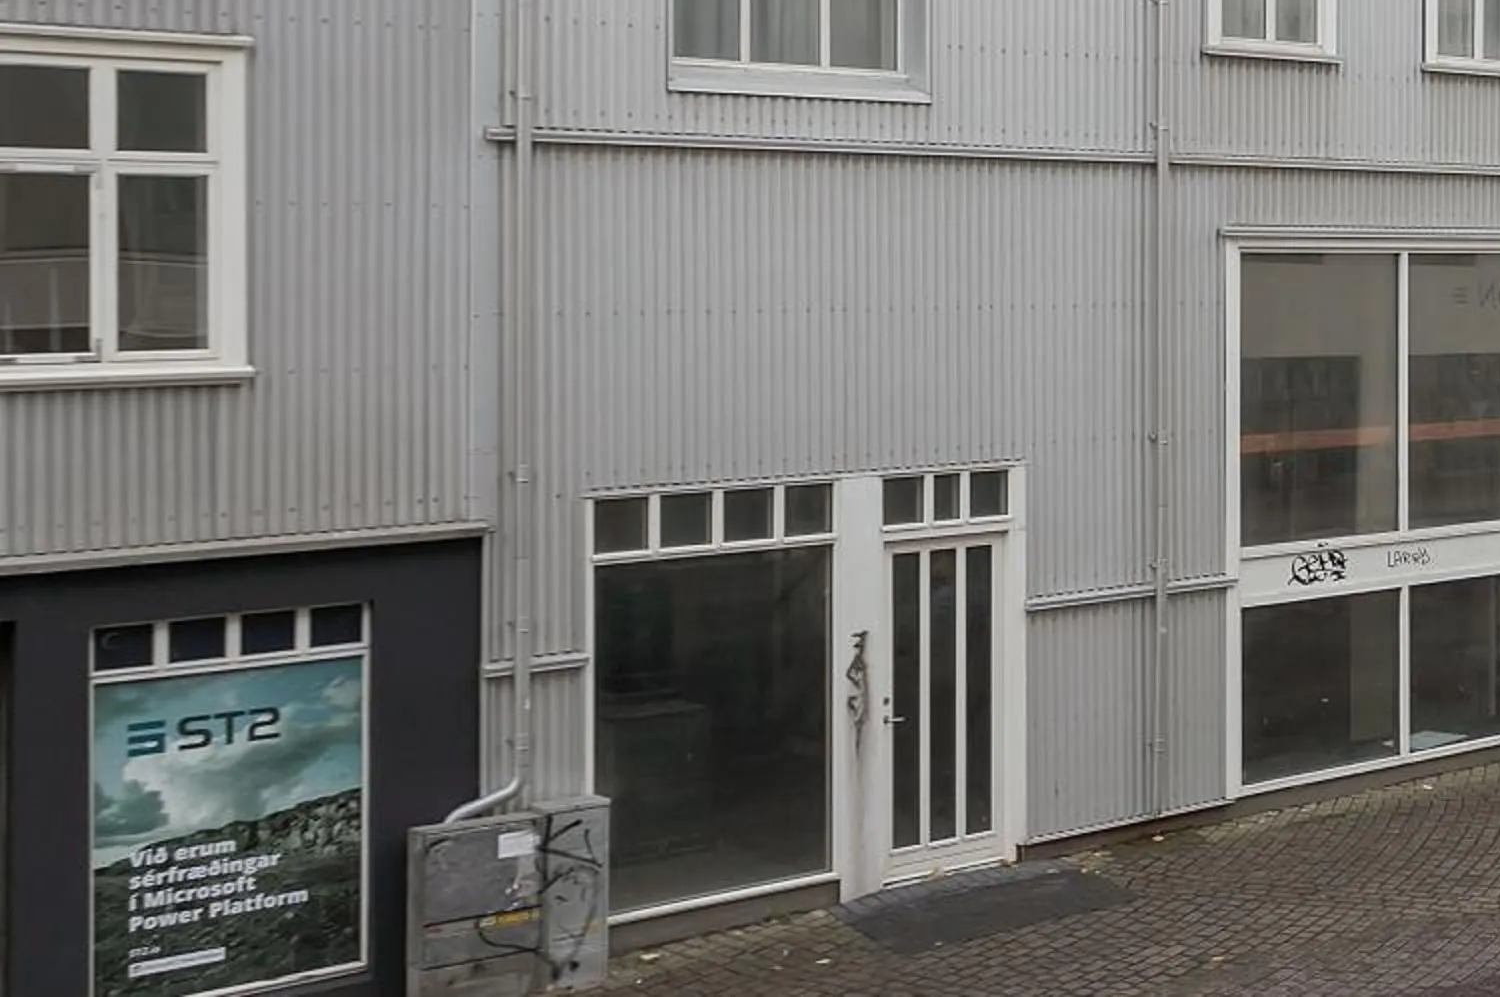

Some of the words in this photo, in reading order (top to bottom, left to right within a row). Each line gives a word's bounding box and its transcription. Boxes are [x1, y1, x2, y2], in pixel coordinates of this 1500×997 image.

[129, 846, 168, 868] Við
[174, 840, 237, 861] erum
[128, 853, 281, 890] sérfræðingar
[143, 876, 257, 908] Microsoft
[128, 907, 204, 933] Power
[208, 889, 309, 918] Platform
